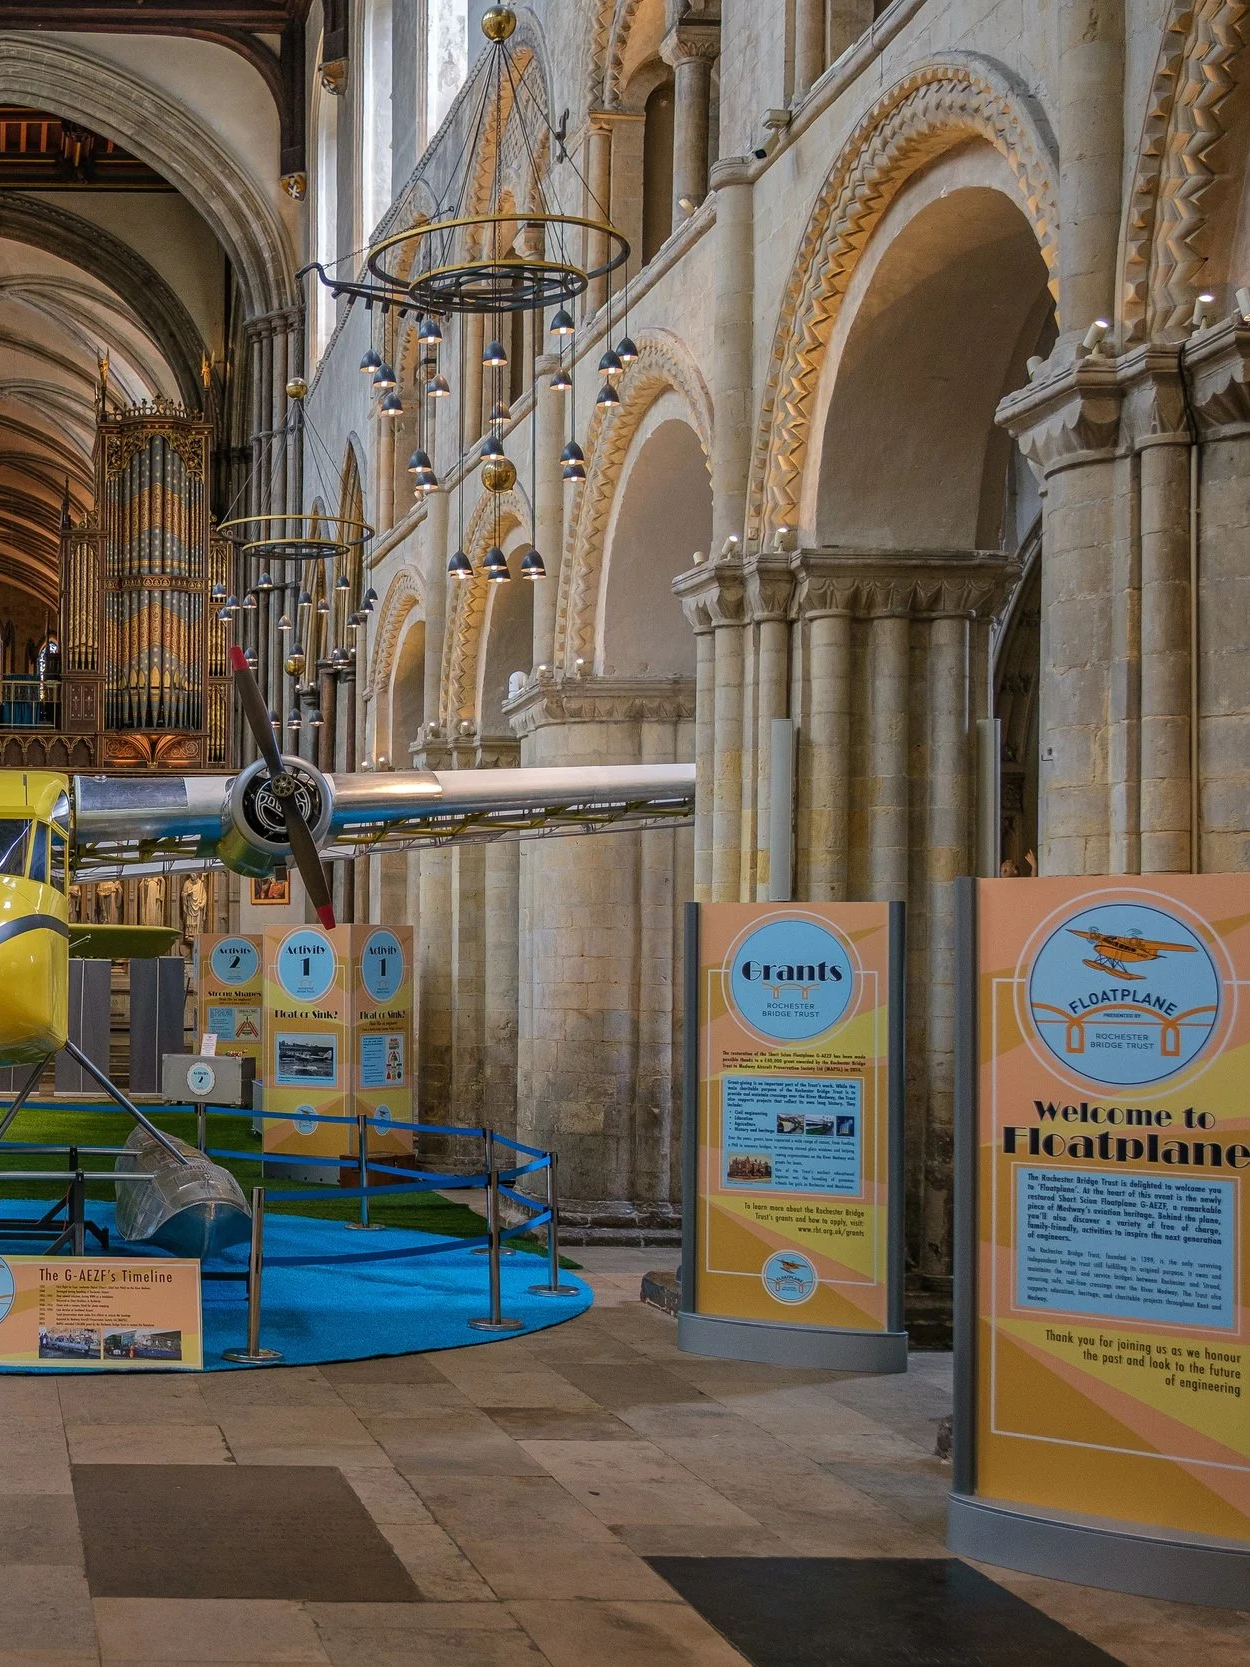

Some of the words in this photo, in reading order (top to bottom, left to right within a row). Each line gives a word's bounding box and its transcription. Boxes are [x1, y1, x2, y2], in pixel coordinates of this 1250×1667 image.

[286, 945, 326, 955] Activity
[368, 945, 397, 955] Activity
[229, 955, 240, 968] 2
[300, 957, 310, 976] 1
[379, 958, 386, 976] 1
[741, 960, 842, 981] Grants
[1069, 989, 1178, 1016] FLOATPLANE
[274, 1010, 298, 1018] Float
[312, 1010, 338, 1019] Sink?
[360, 1011, 377, 1019] Float
[378, 1011, 385, 1019] or
[388, 1011, 405, 1019] Sink?
[1096, 1033, 1148, 1041] ROCHESTER
[1126, 1042, 1155, 1050] TRUST
[1033, 1100, 1172, 1127] Welcome
[1183, 1107, 1216, 1129] to
[1003, 1125, 1250, 1169] Floatplane
[1027, 1173, 1038, 1181] The
[1041, 1174, 1073, 1183] Rochester
[1076, 1176, 1098, 1186] Bridge
[1101, 1178, 1118, 1186] Trust
[1121, 1178, 1127, 1187] is
[1129, 1180, 1162, 1190] delighted
[1175, 1184, 1206, 1192] welcome
[1027, 1193, 1055, 1201] restored
[1058, 1194, 1076, 1203] Short
[1079, 1196, 1097, 1204] Scion
[1100, 1198, 1137, 1207] Floatplane
[1180, 1205, 1222, 1214] remarkable
[1093, 1187, 1104, 1195] the
[1106, 1188, 1125, 1196] heart
[1138, 1190, 1151, 1199] this
[1176, 1193, 1182, 1201] is
[1185, 1194, 1197, 1202] the
[1200, 1196, 1222, 1205] newly
[755, 1213, 773, 1221] Trust's
[830, 1218, 847, 1227] apply,
[850, 1219, 864, 1227] visit:
[786, 1205, 802, 1213] about
[804, 1206, 813, 1214] the
[816, 1206, 843, 1215] Rochester
[845, 1209, 865, 1218] Bridge
[798, 1226, 865, 1237] www.rbt.org.uk/grants
[39, 1268, 58, 1281] The
[65, 1269, 116, 1282] G-AEZF's
[122, 1270, 173, 1283] Timeline
[1045, 1329, 1073, 1344] Thank
[1077, 1337, 1095, 1347] you
[1099, 1335, 1113, 1348] for
[1117, 1339, 1151, 1355] joining
[1156, 1345, 1166, 1355] us
[1171, 1347, 1182, 1356] as
[1187, 1348, 1200, 1359] we
[1204, 1347, 1241, 1363] honour
[1083, 1349, 1098, 1361] the
[1102, 1353, 1122, 1366] past
[1126, 1354, 1145, 1367] and
[1149, 1356, 1170, 1370] look
[1175, 1360, 1184, 1372] to
[1189, 1361, 1204, 1375] the
[1209, 1364, 1241, 1379] future
[1165, 1374, 1176, 1386] of
[1180, 1378, 1241, 1397] engineering
